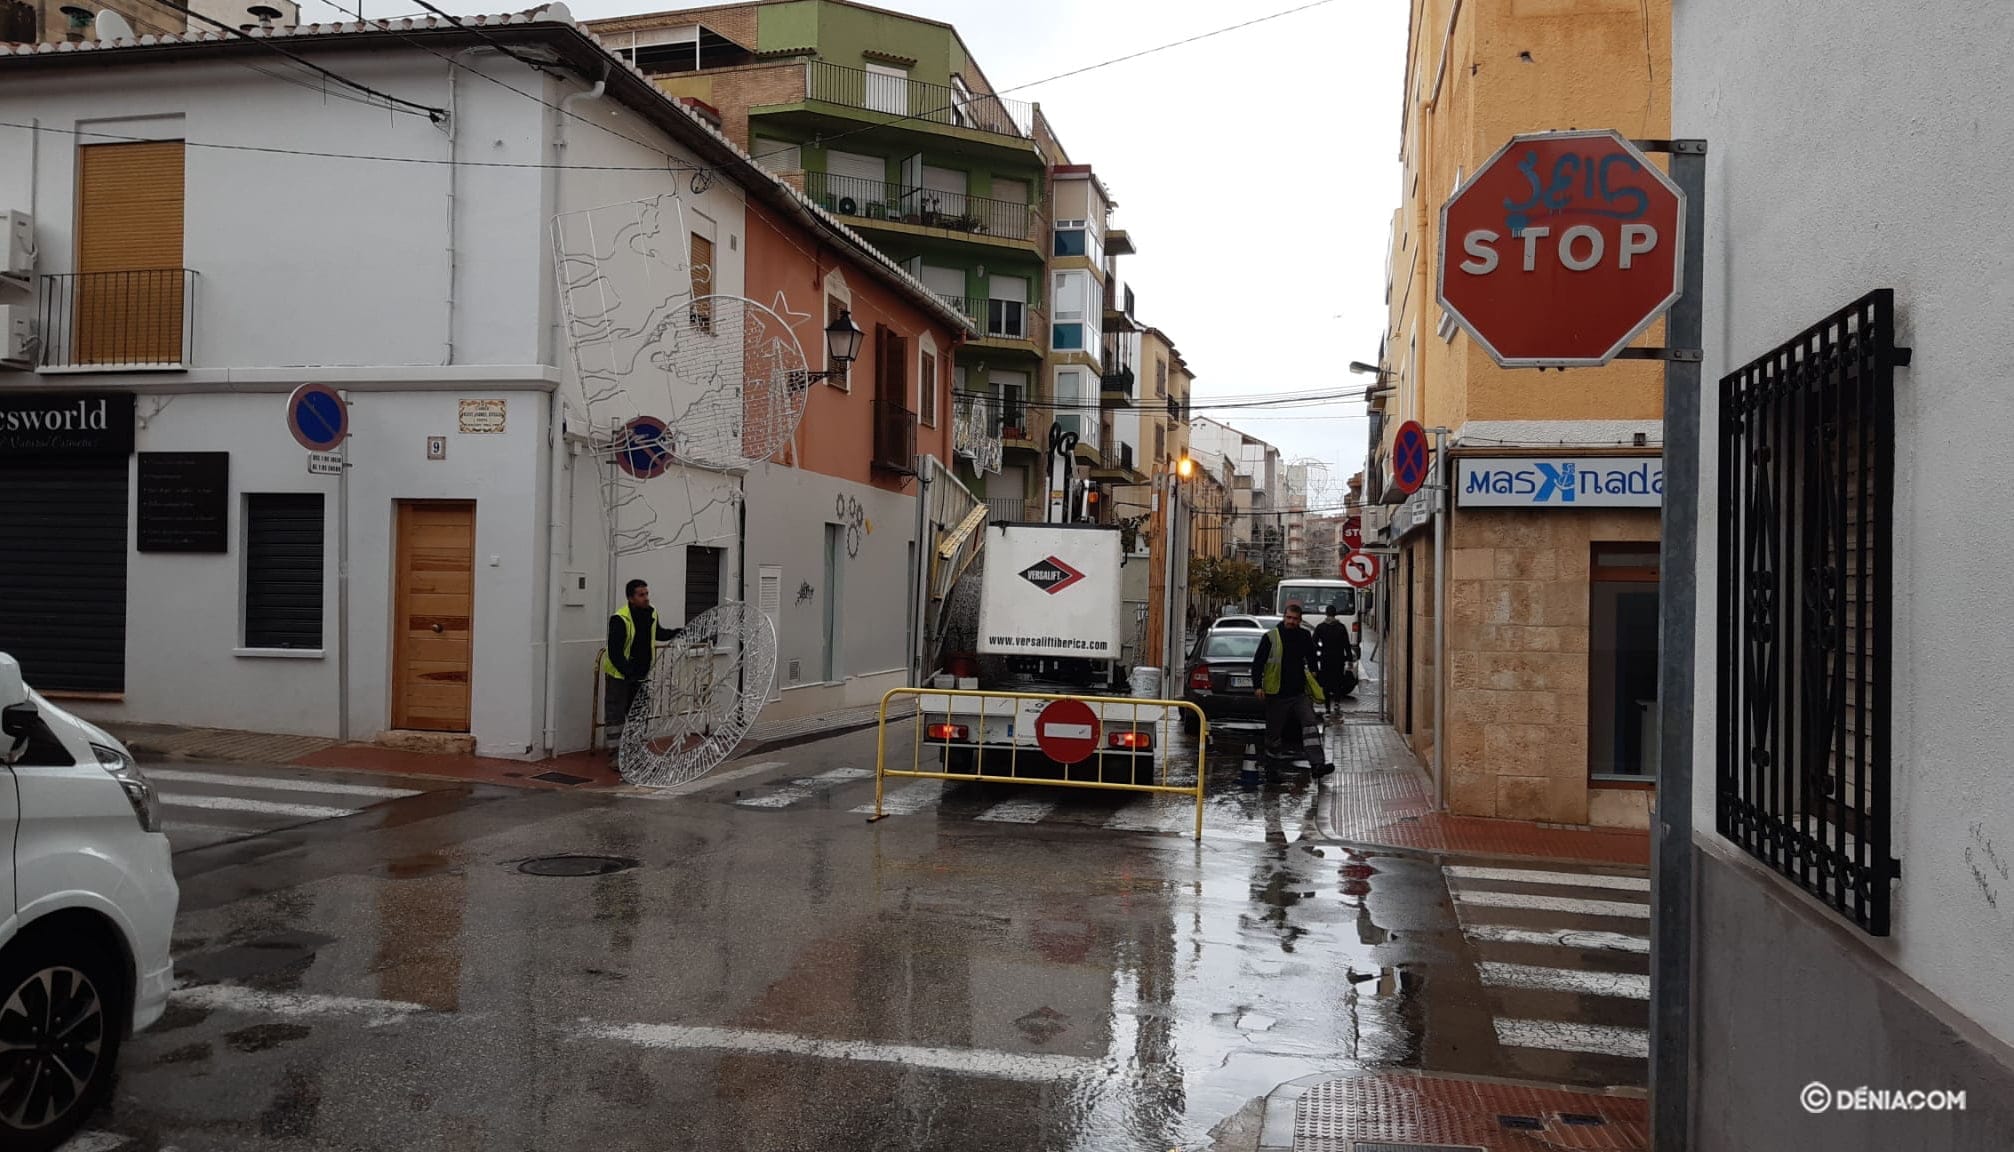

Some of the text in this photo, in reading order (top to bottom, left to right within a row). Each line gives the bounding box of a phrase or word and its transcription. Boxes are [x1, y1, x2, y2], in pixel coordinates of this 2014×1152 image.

[1459, 223, 1659, 276] STOP
[433, 441, 440, 454] 9
[1344, 528, 1362, 537] ST
[1027, 569, 1061, 581] VERSALIFT
[989, 636, 1108, 651] www.versaliftiberica.com
